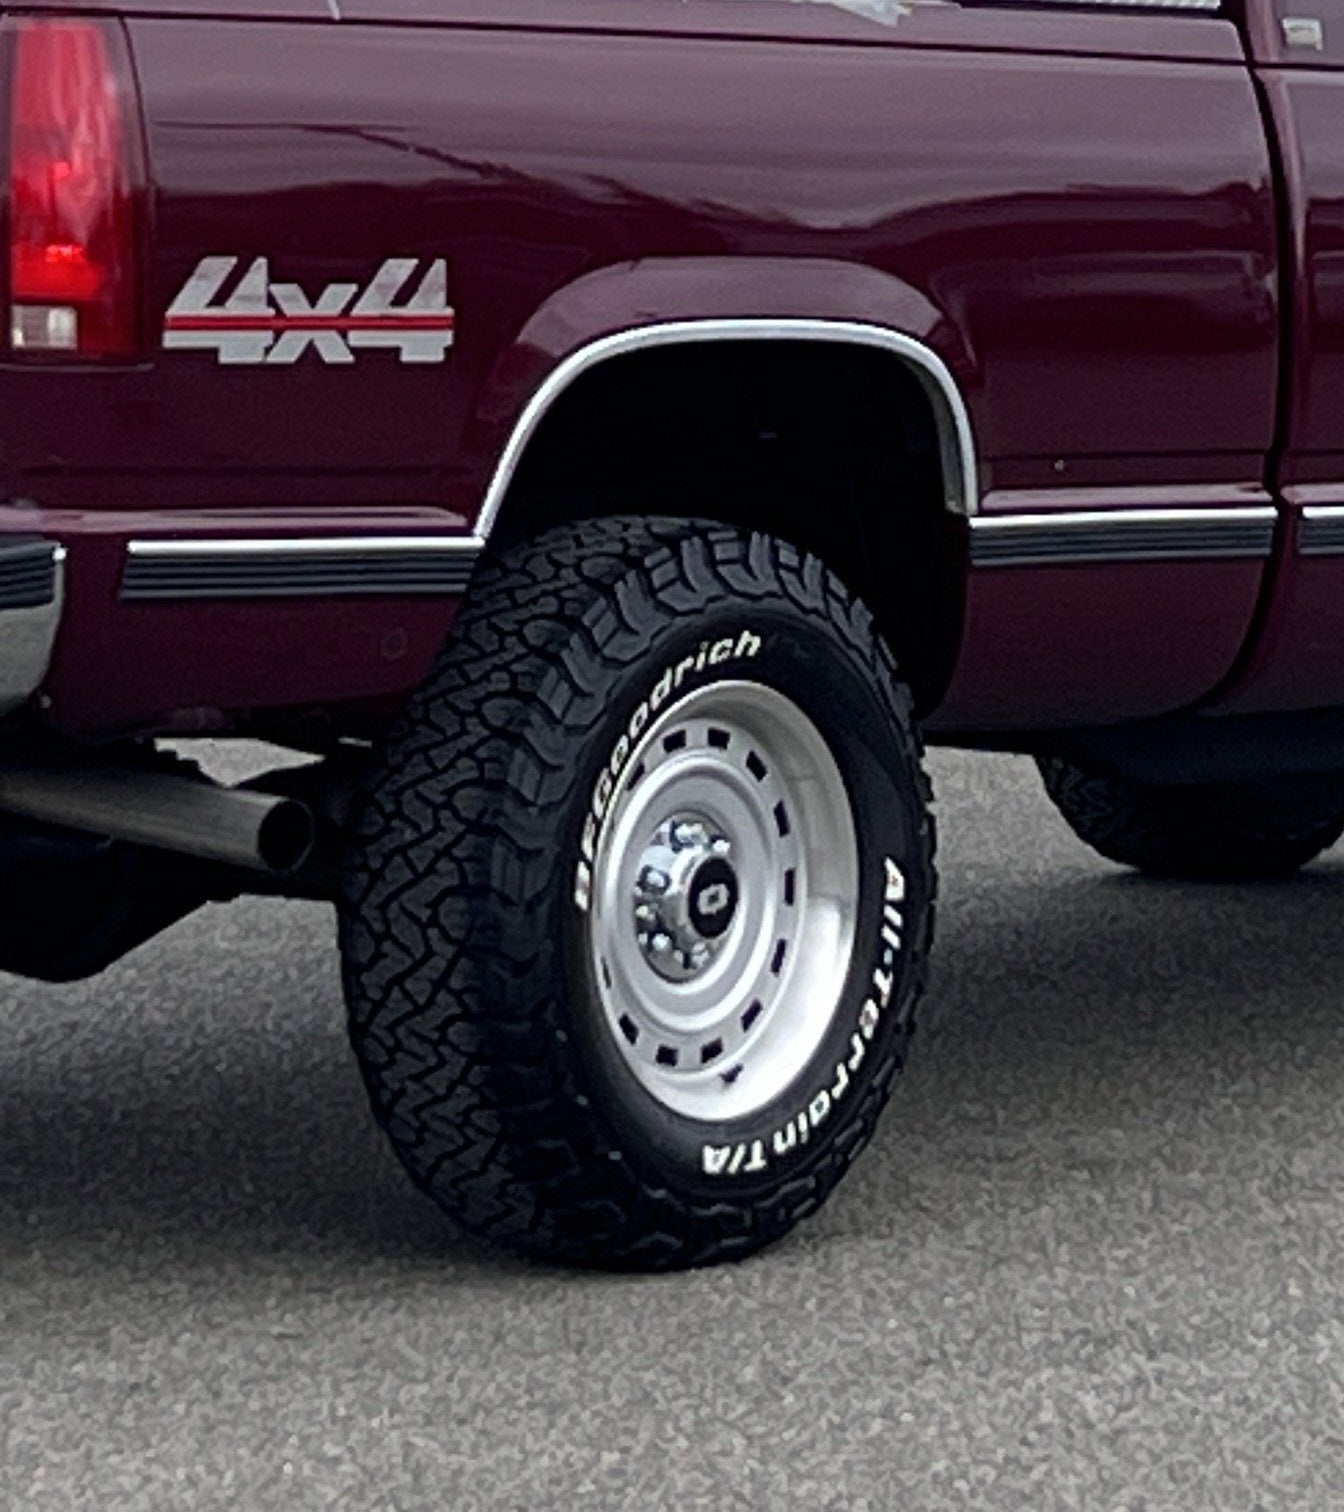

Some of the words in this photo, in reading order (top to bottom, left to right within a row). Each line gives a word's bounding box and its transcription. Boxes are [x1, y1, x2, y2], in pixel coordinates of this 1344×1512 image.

[574, 629, 762, 912] BFGoodrich
[772, 856, 905, 1155] All-Terrain
[702, 1139, 767, 1175] T/A
